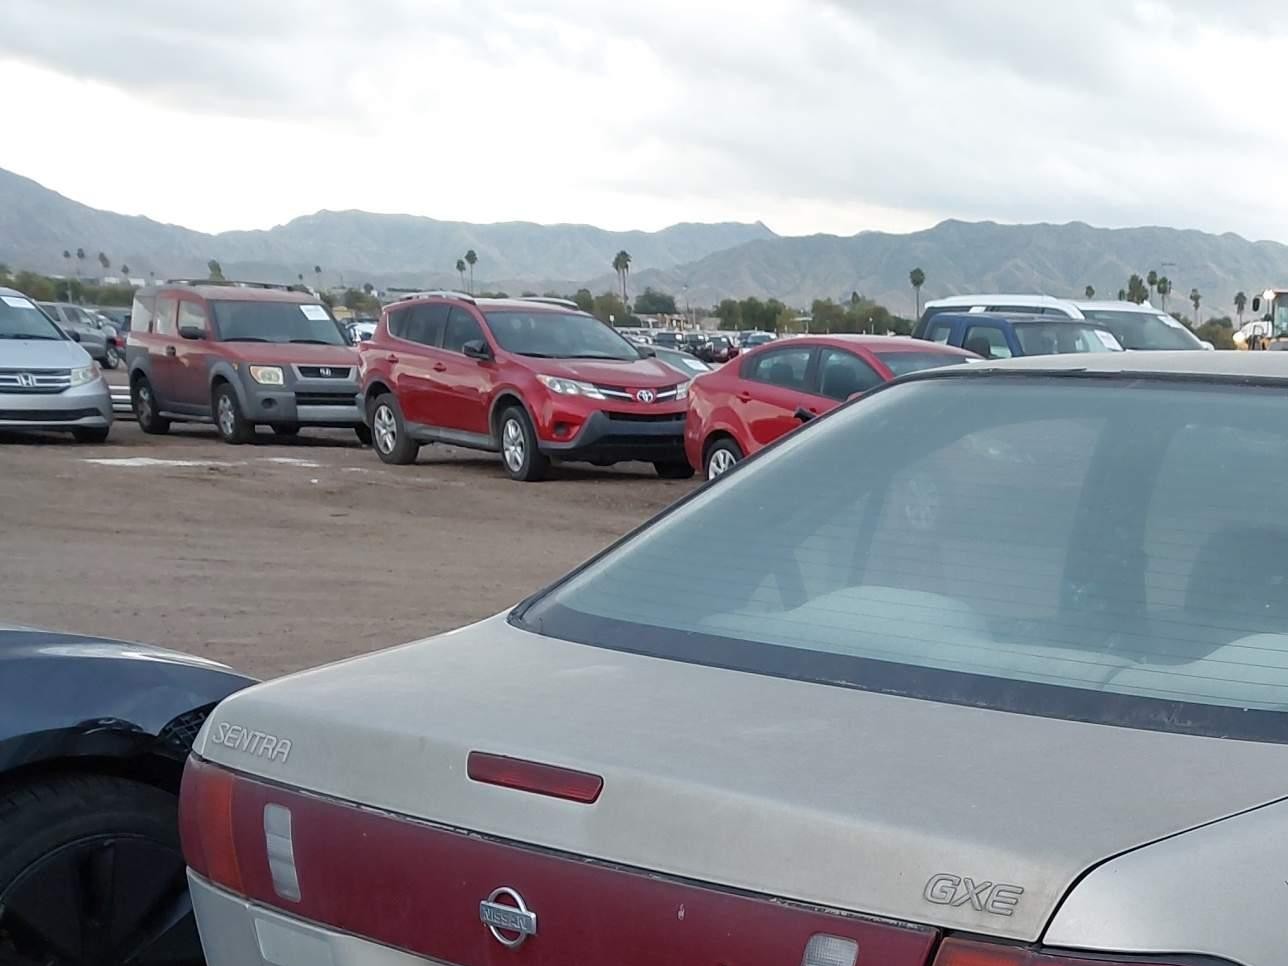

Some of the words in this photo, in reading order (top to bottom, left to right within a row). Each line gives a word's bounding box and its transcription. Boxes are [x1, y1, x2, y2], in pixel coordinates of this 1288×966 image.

[212, 722, 292, 763] SENTRA
[923, 873, 1024, 916] GXE
[482, 907, 528, 931] NISSAN
